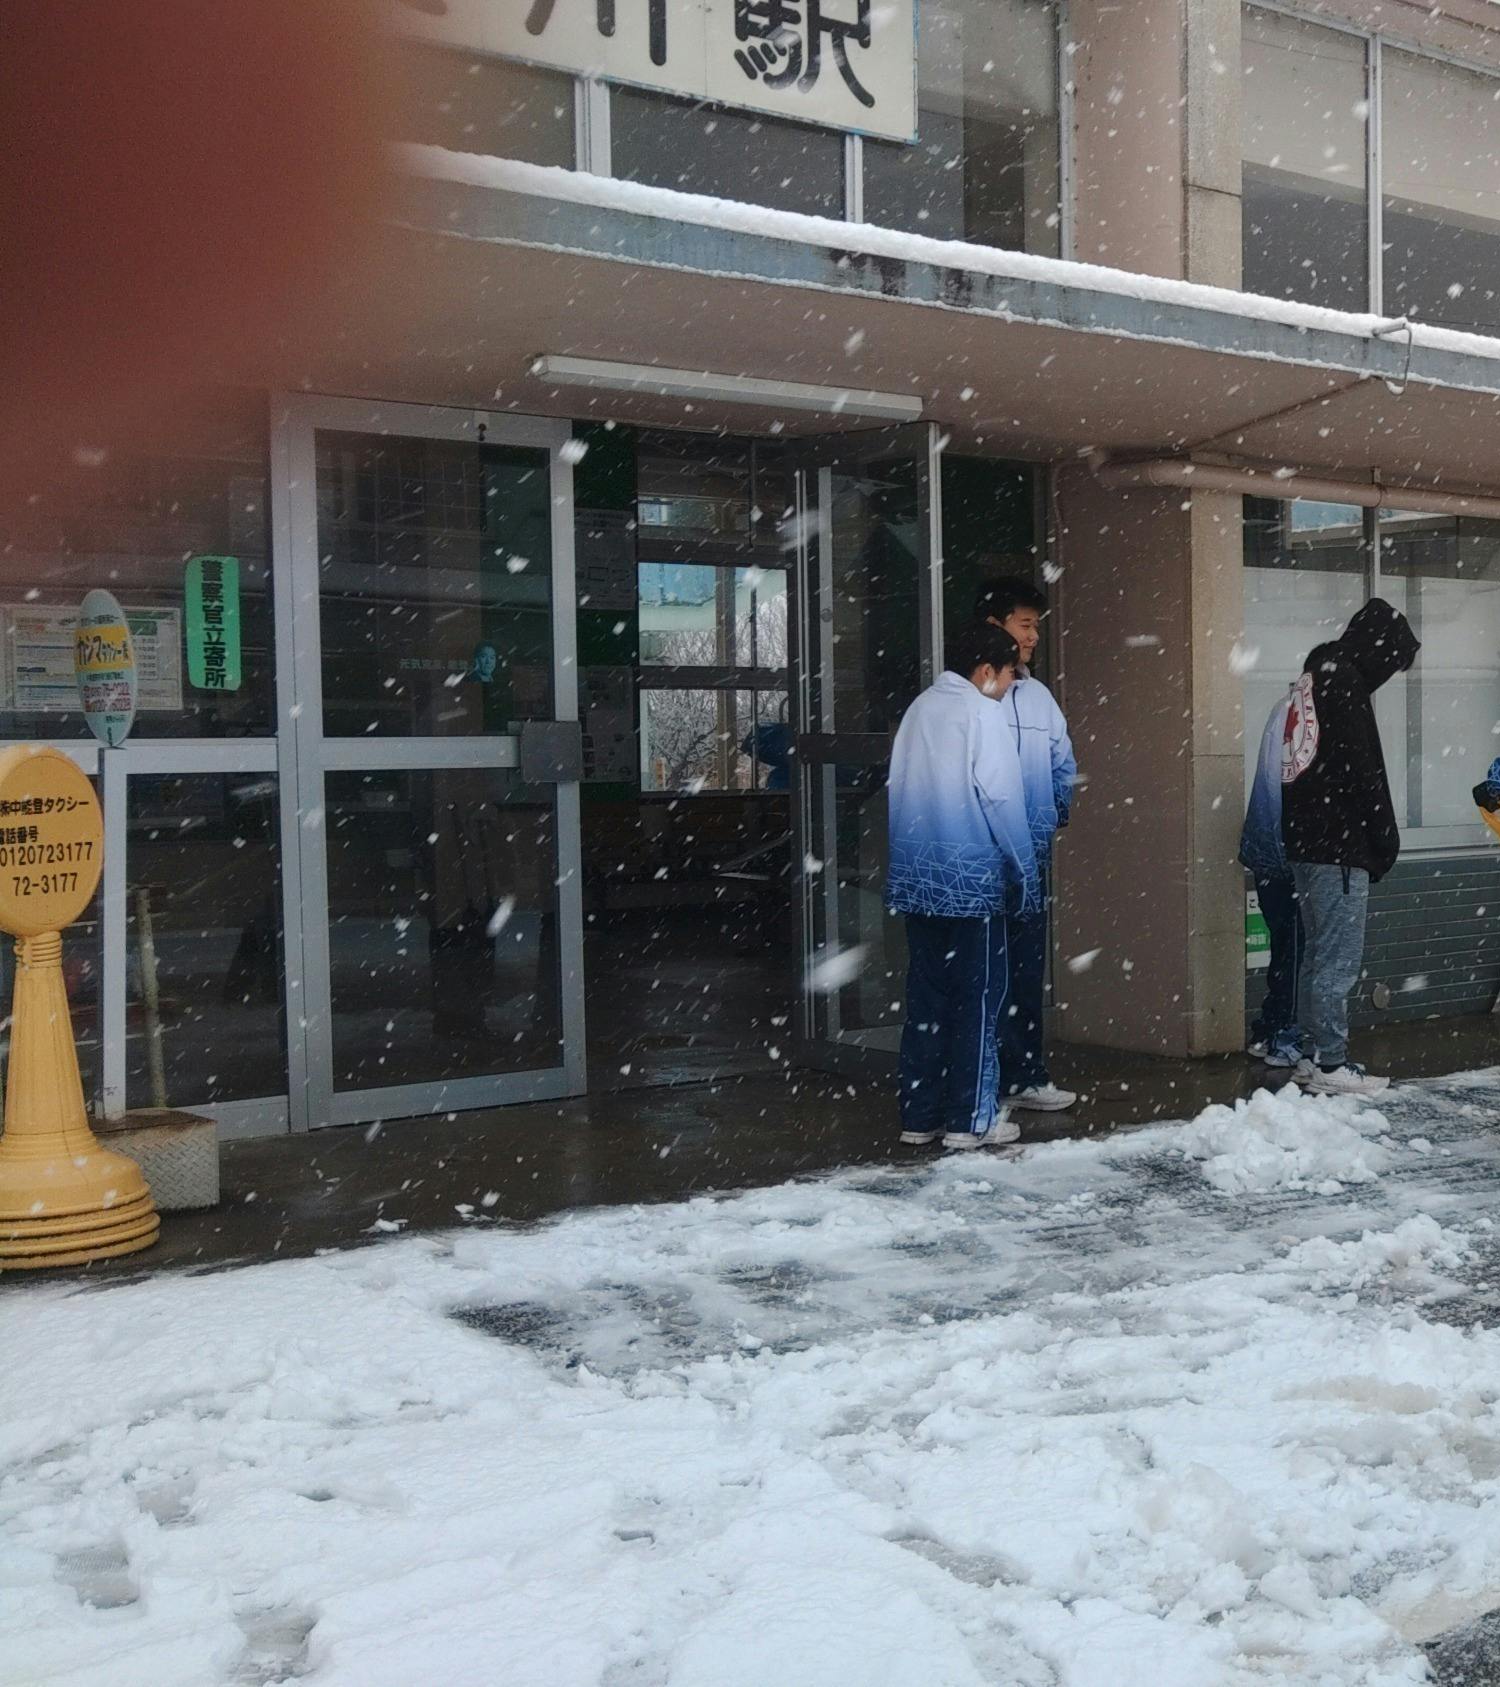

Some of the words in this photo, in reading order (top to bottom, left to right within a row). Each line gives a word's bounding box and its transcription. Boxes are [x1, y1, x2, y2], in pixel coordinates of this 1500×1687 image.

[201, 560, 226, 688] 警察官立寄所
[0, 842, 93, 867] 0120723177
[12, 872, 78, 897] 72-3177
